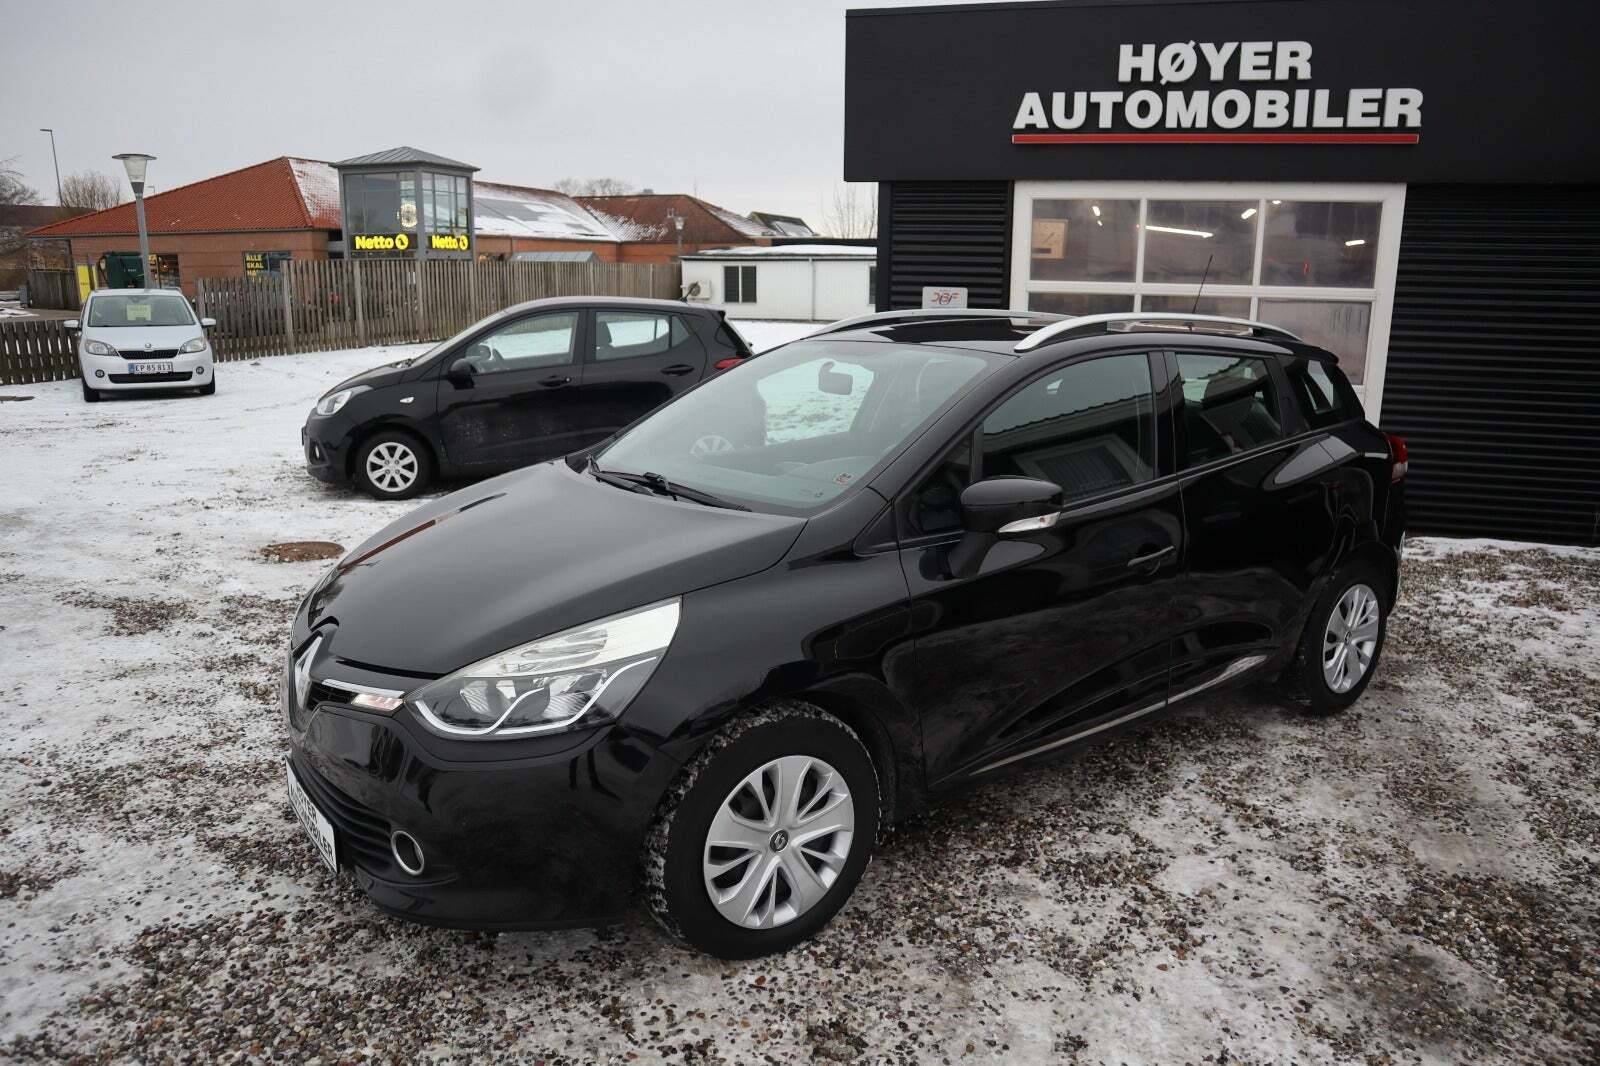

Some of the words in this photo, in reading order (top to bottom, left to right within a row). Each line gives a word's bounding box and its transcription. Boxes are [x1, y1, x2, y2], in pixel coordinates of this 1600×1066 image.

[1118, 40, 1313, 85] HØYER
[1012, 88, 1424, 129] AUTOMOBILER
[355, 235, 394, 249] Netto
[431, 234, 458, 249] Netto
